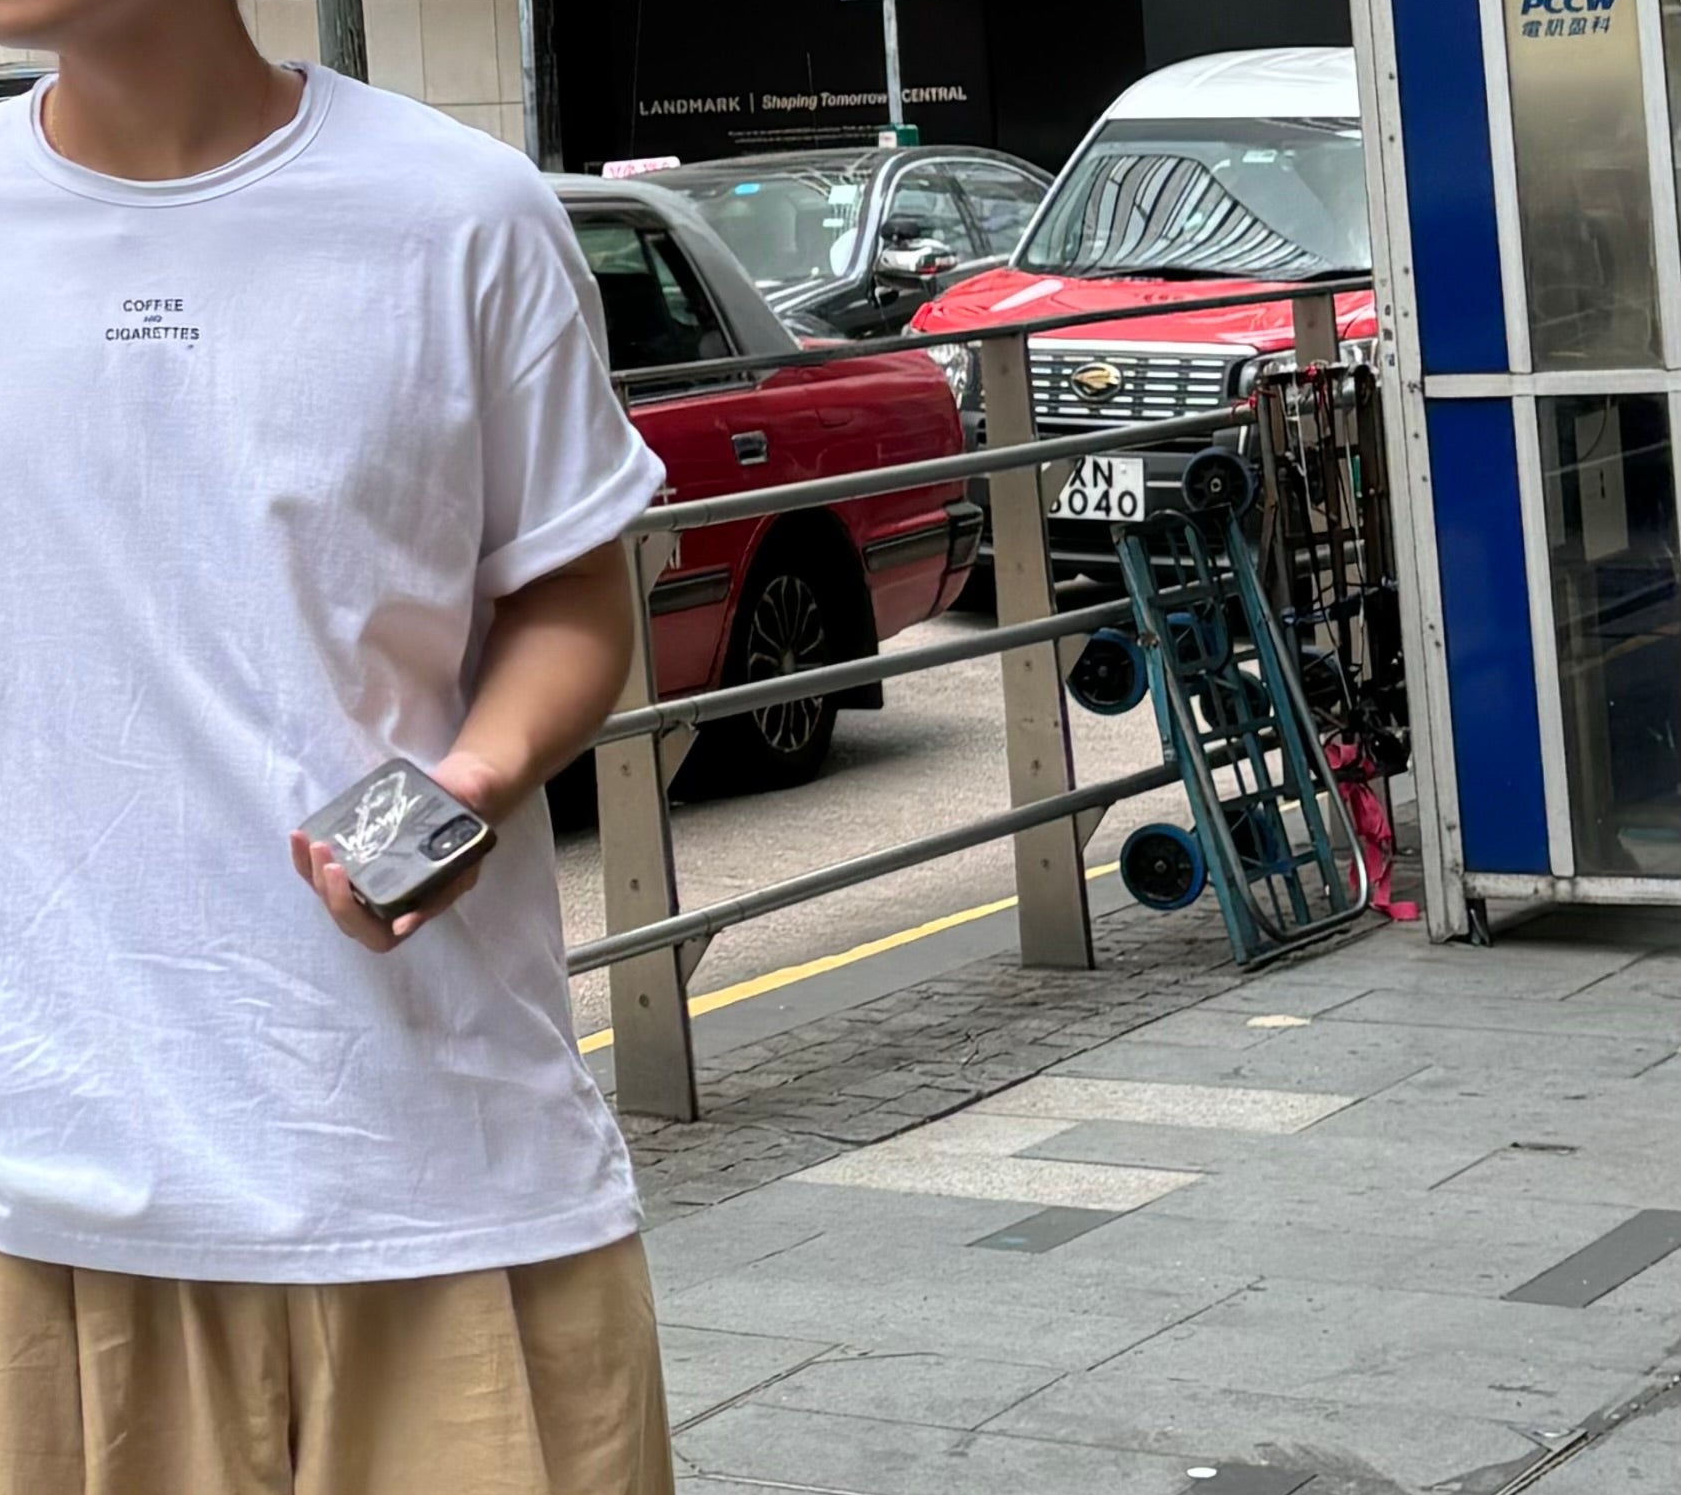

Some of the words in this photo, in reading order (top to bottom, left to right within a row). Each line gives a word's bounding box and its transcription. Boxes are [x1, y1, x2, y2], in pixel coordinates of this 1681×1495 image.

[639, 95, 741, 116] LANDMARK
[762, 94, 818, 112] Shaping
[902, 86, 967, 103] CENTRAL
[122, 298, 184, 313] COFFEE
[105, 326, 200, 341] CIGARETTES
